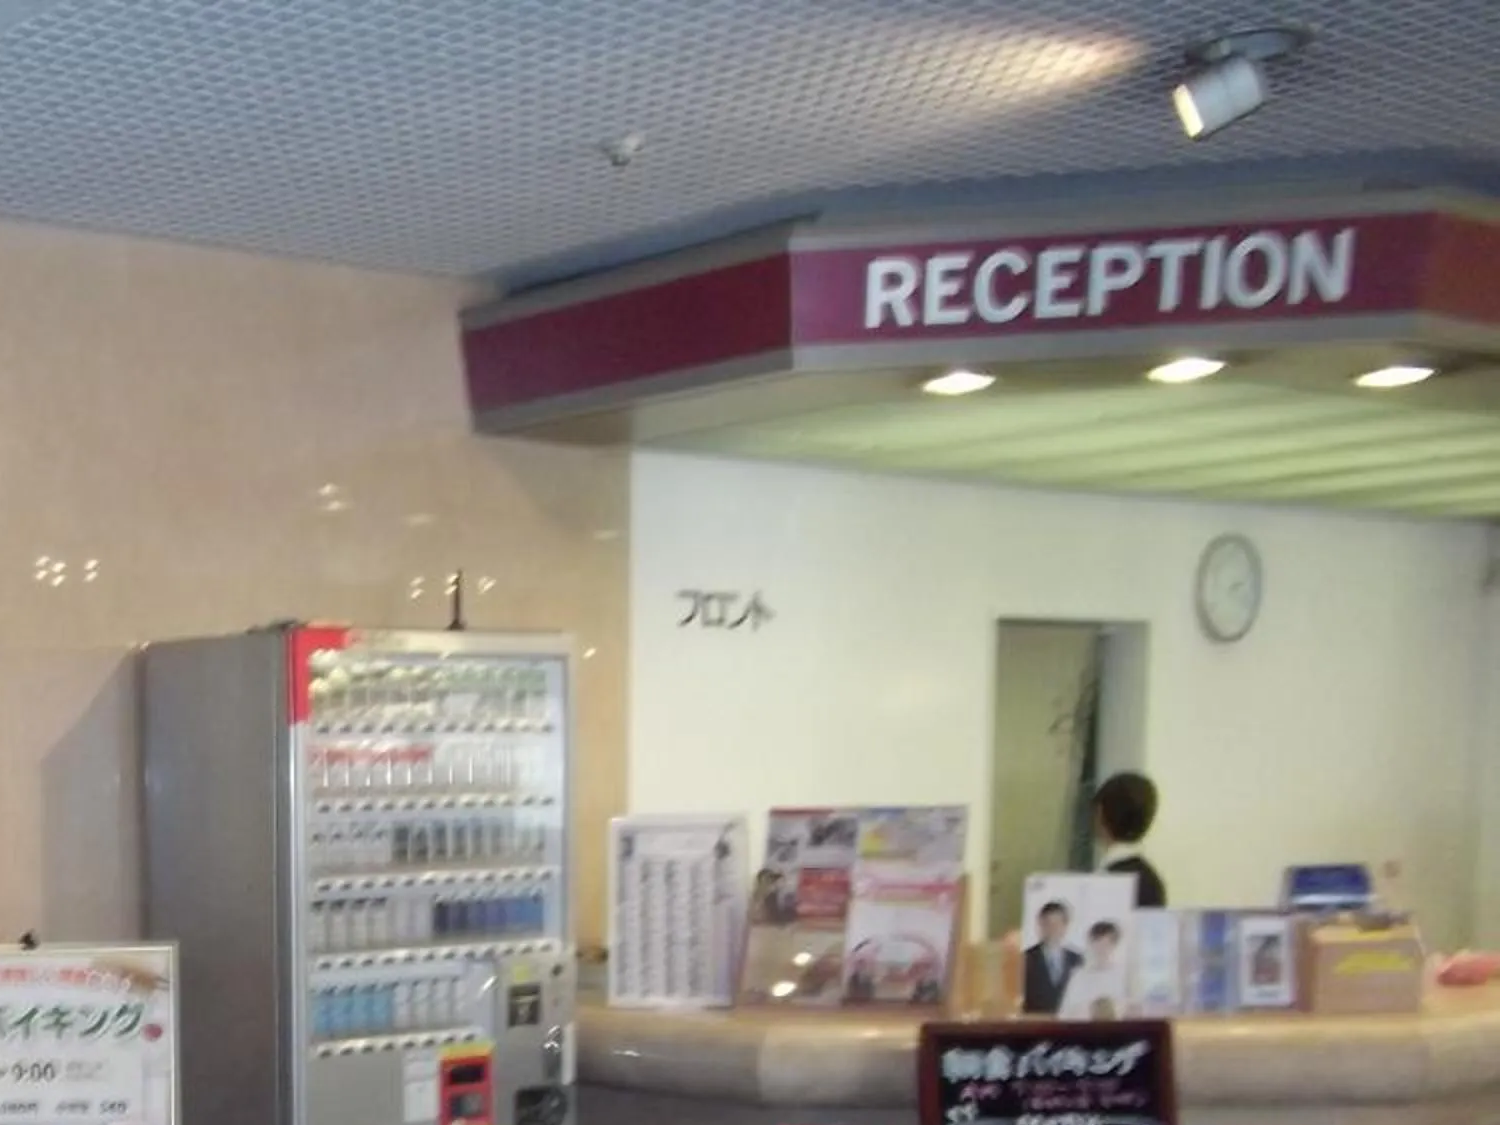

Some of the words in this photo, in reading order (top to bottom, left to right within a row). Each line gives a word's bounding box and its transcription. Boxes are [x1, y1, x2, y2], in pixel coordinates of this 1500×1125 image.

[863, 227, 1356, 329] RECEPTION
[674, 588, 778, 633] フロント
